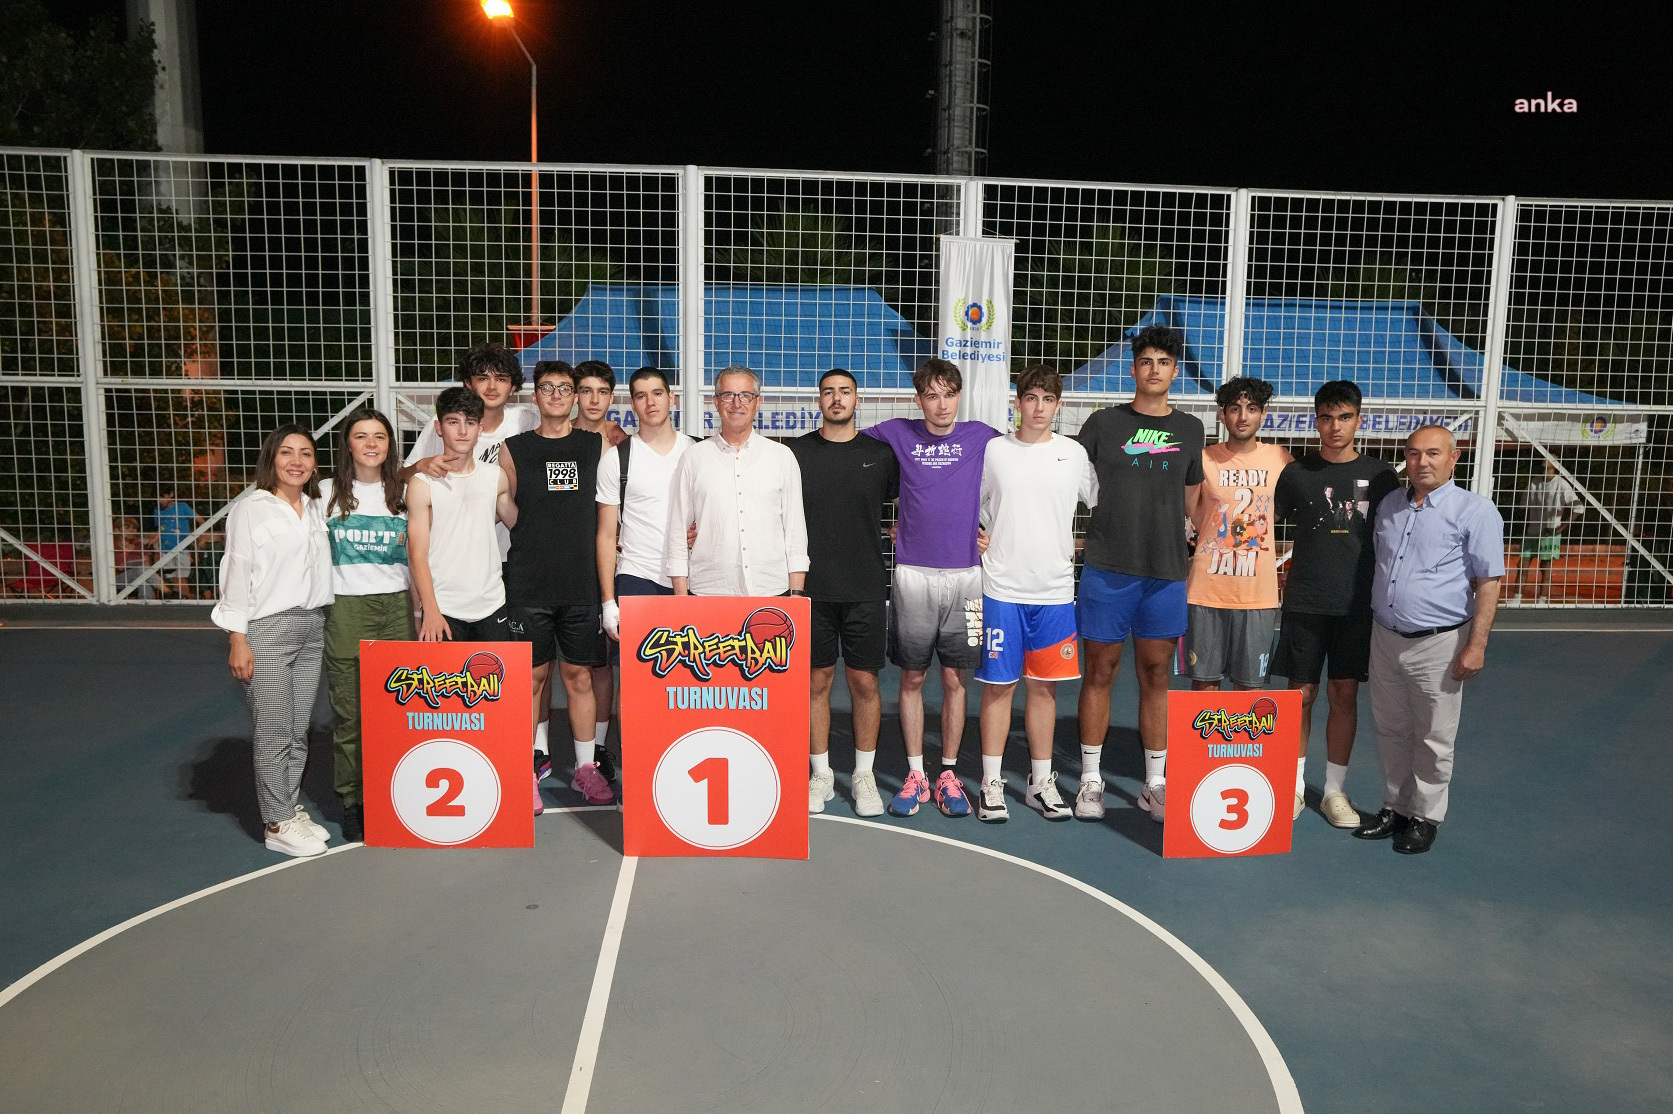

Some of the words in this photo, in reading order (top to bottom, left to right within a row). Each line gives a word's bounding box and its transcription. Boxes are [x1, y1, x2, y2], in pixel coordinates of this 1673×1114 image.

[945, 336, 1002, 349] Gaziemir
[941, 349, 1006, 363] Belediyesi
[1132, 428, 1171, 445] NIKE
[1131, 457, 1169, 470] AIR
[548, 468, 577, 479] 1998
[1218, 469, 1269, 487] READY
[1232, 487, 1254, 522] 2
[333, 528, 396, 544] PORT
[1206, 549, 1259, 577] JAM
[985, 627, 1005, 652] 12
[665, 686, 768, 711] TURNUVASI
[405, 712, 485, 731] TURNUVASI
[1207, 743, 1263, 758] TURNUVASI
[425, 767, 466, 817] 2
[687, 757, 729, 825] 1
[1218, 788, 1250, 830] 3
